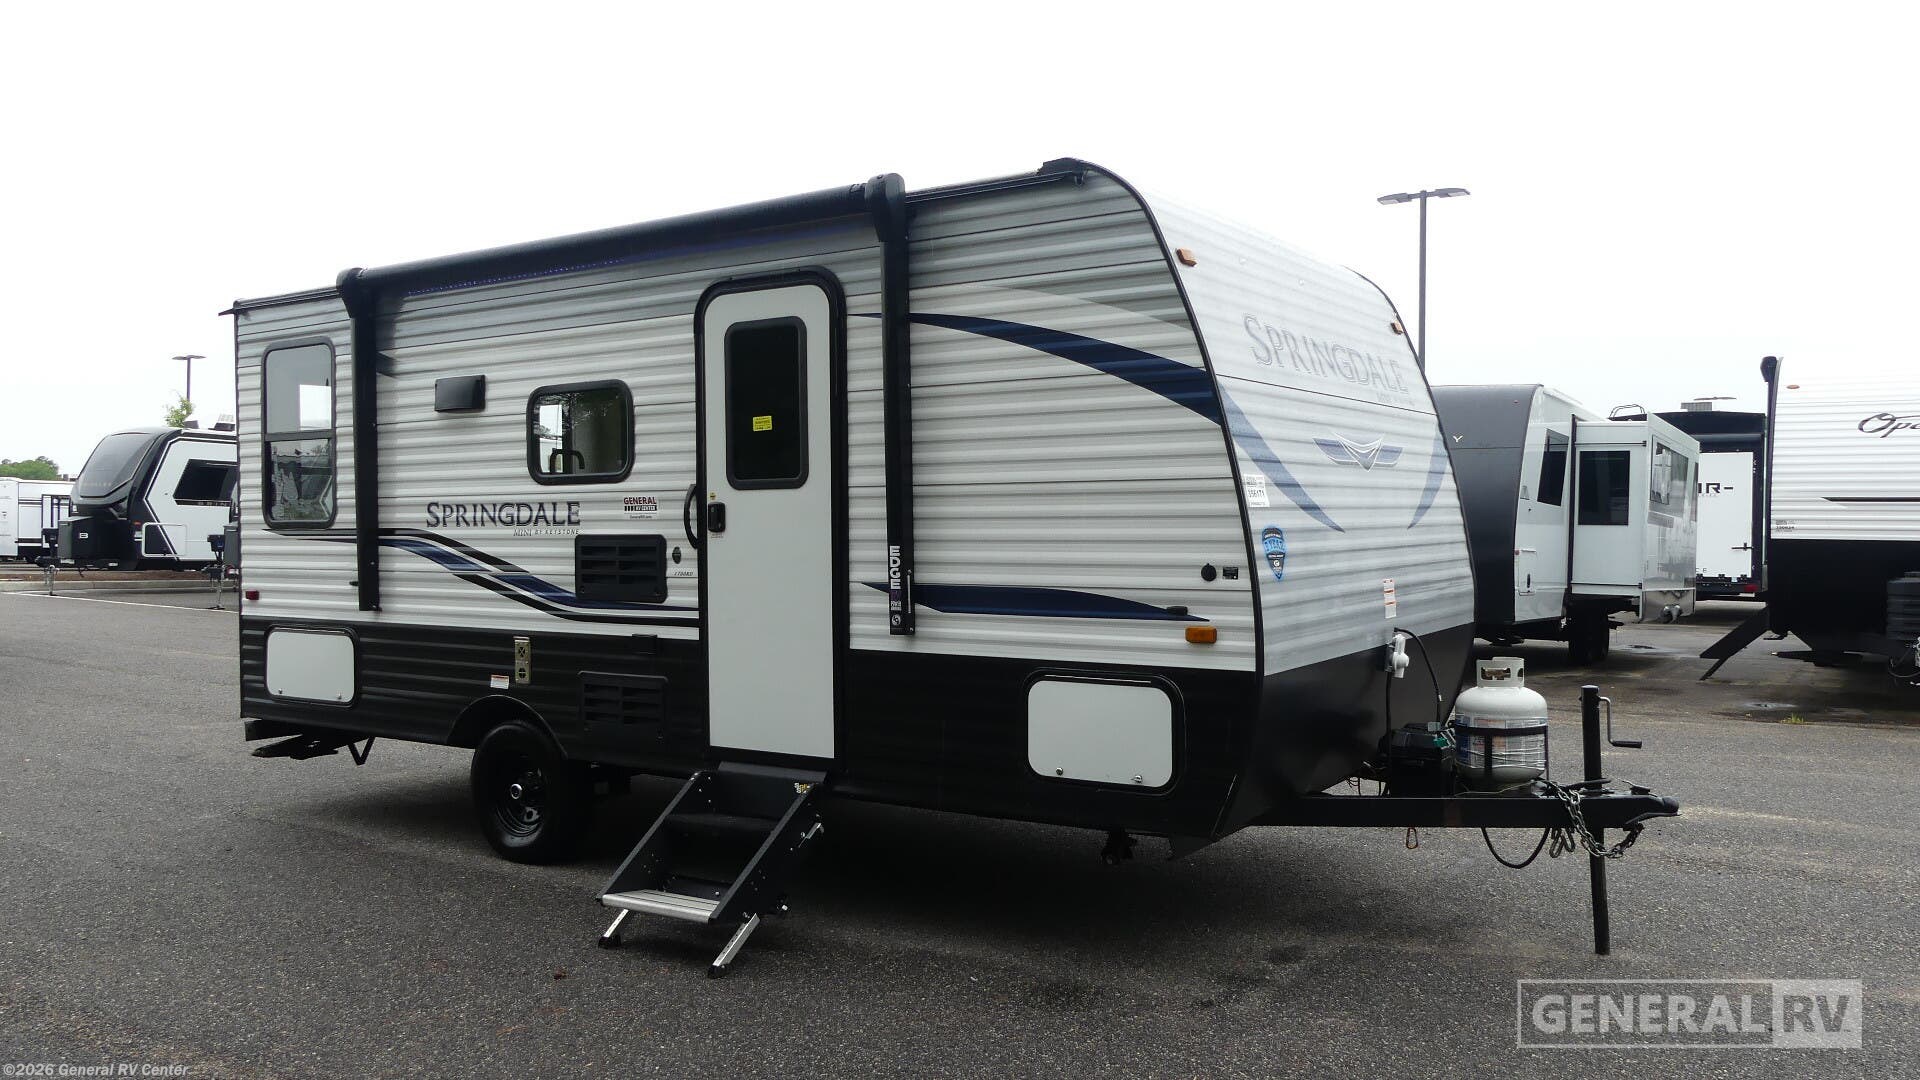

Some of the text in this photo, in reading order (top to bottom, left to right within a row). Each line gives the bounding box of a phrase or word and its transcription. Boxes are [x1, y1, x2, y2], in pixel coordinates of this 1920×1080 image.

[1243, 314, 1408, 394] SPRINGDALE
[623, 496, 657, 505] GENERAL
[426, 502, 581, 527] SPRINGDALE
[513, 528, 532, 537] MINI
[889, 545, 902, 590] EDGE
